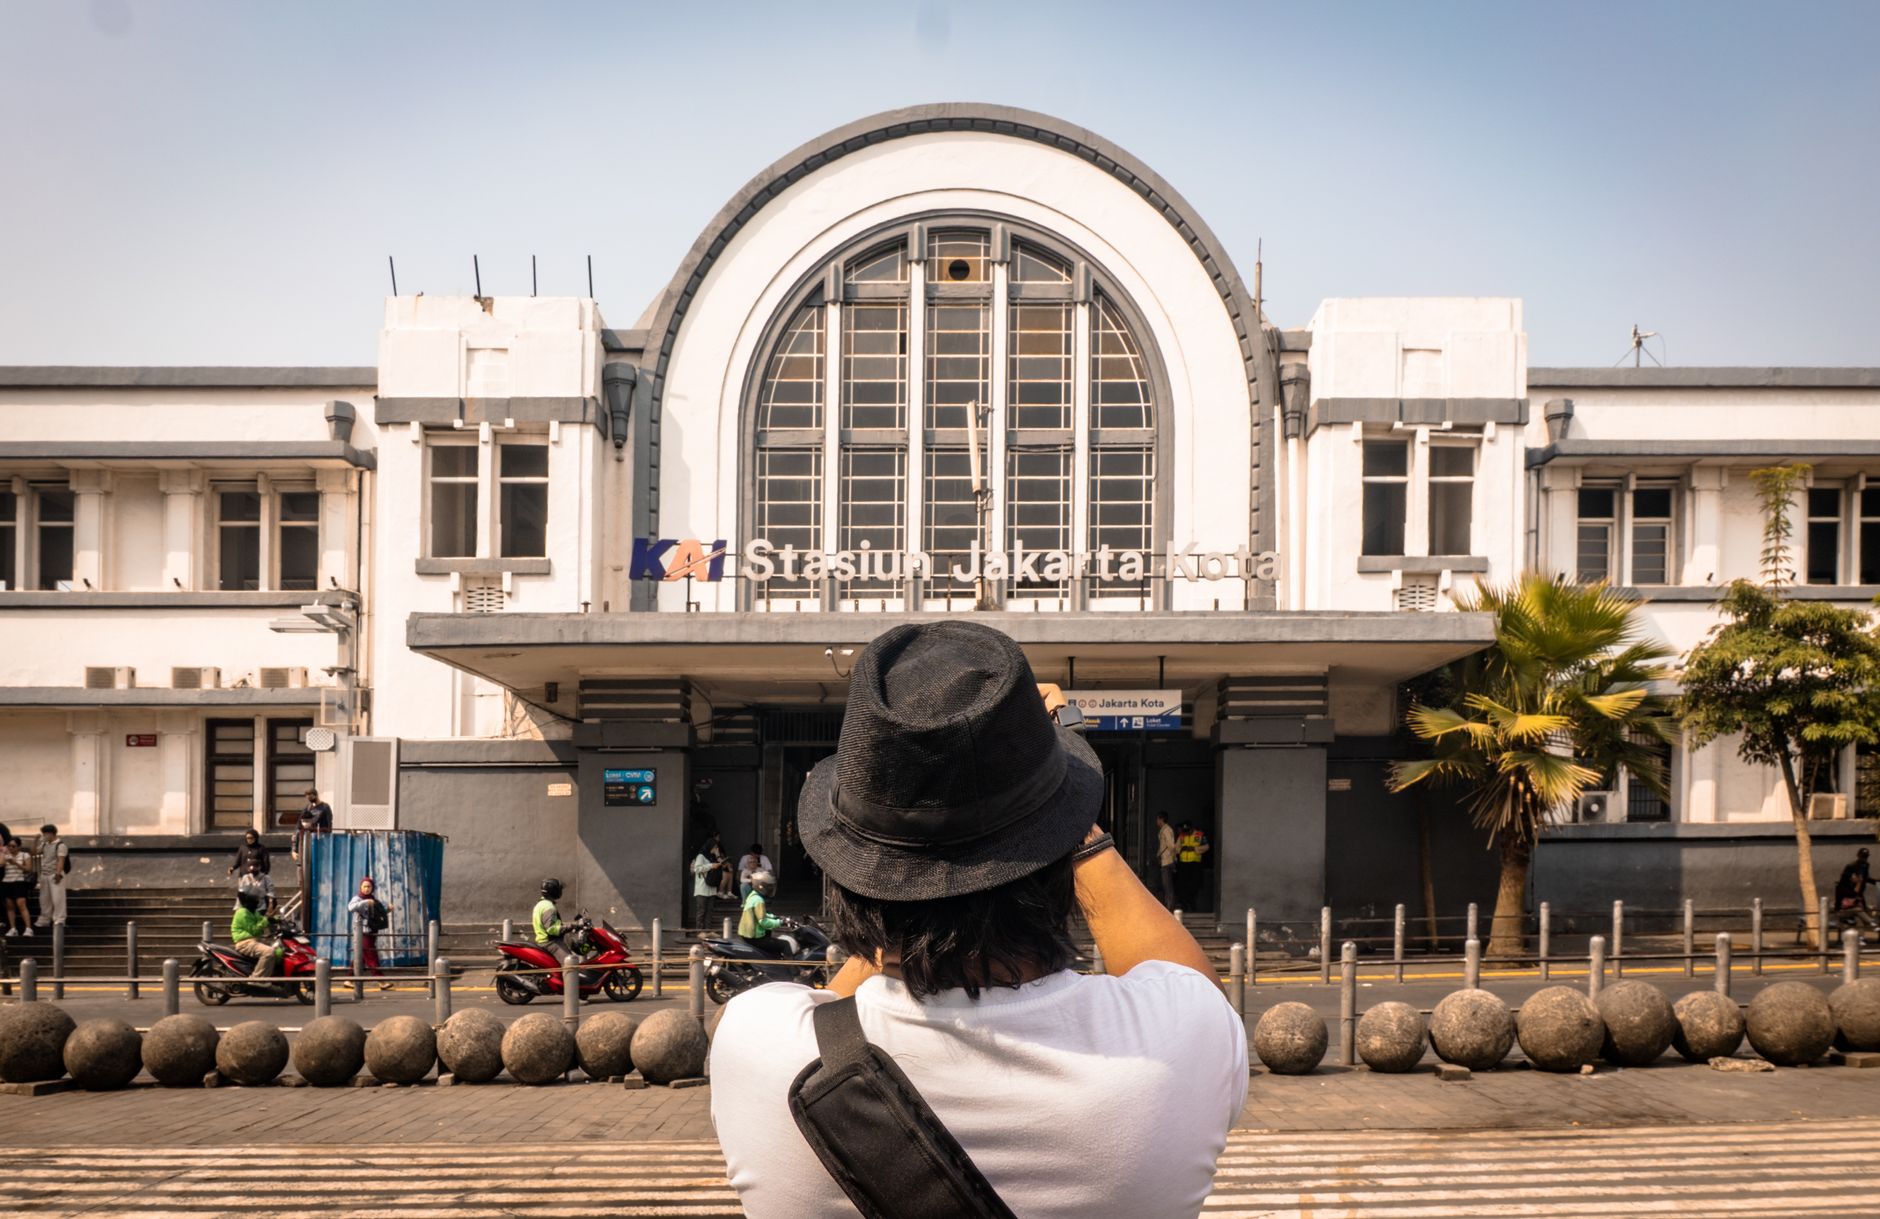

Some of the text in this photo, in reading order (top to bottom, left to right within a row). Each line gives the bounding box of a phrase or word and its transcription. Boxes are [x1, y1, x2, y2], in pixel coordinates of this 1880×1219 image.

[629, 537, 1282, 582] KAI Stasiun Jakarta Kota
[1099, 698, 1138, 708] Jakarta
[1140, 698, 1165, 708] Kota
